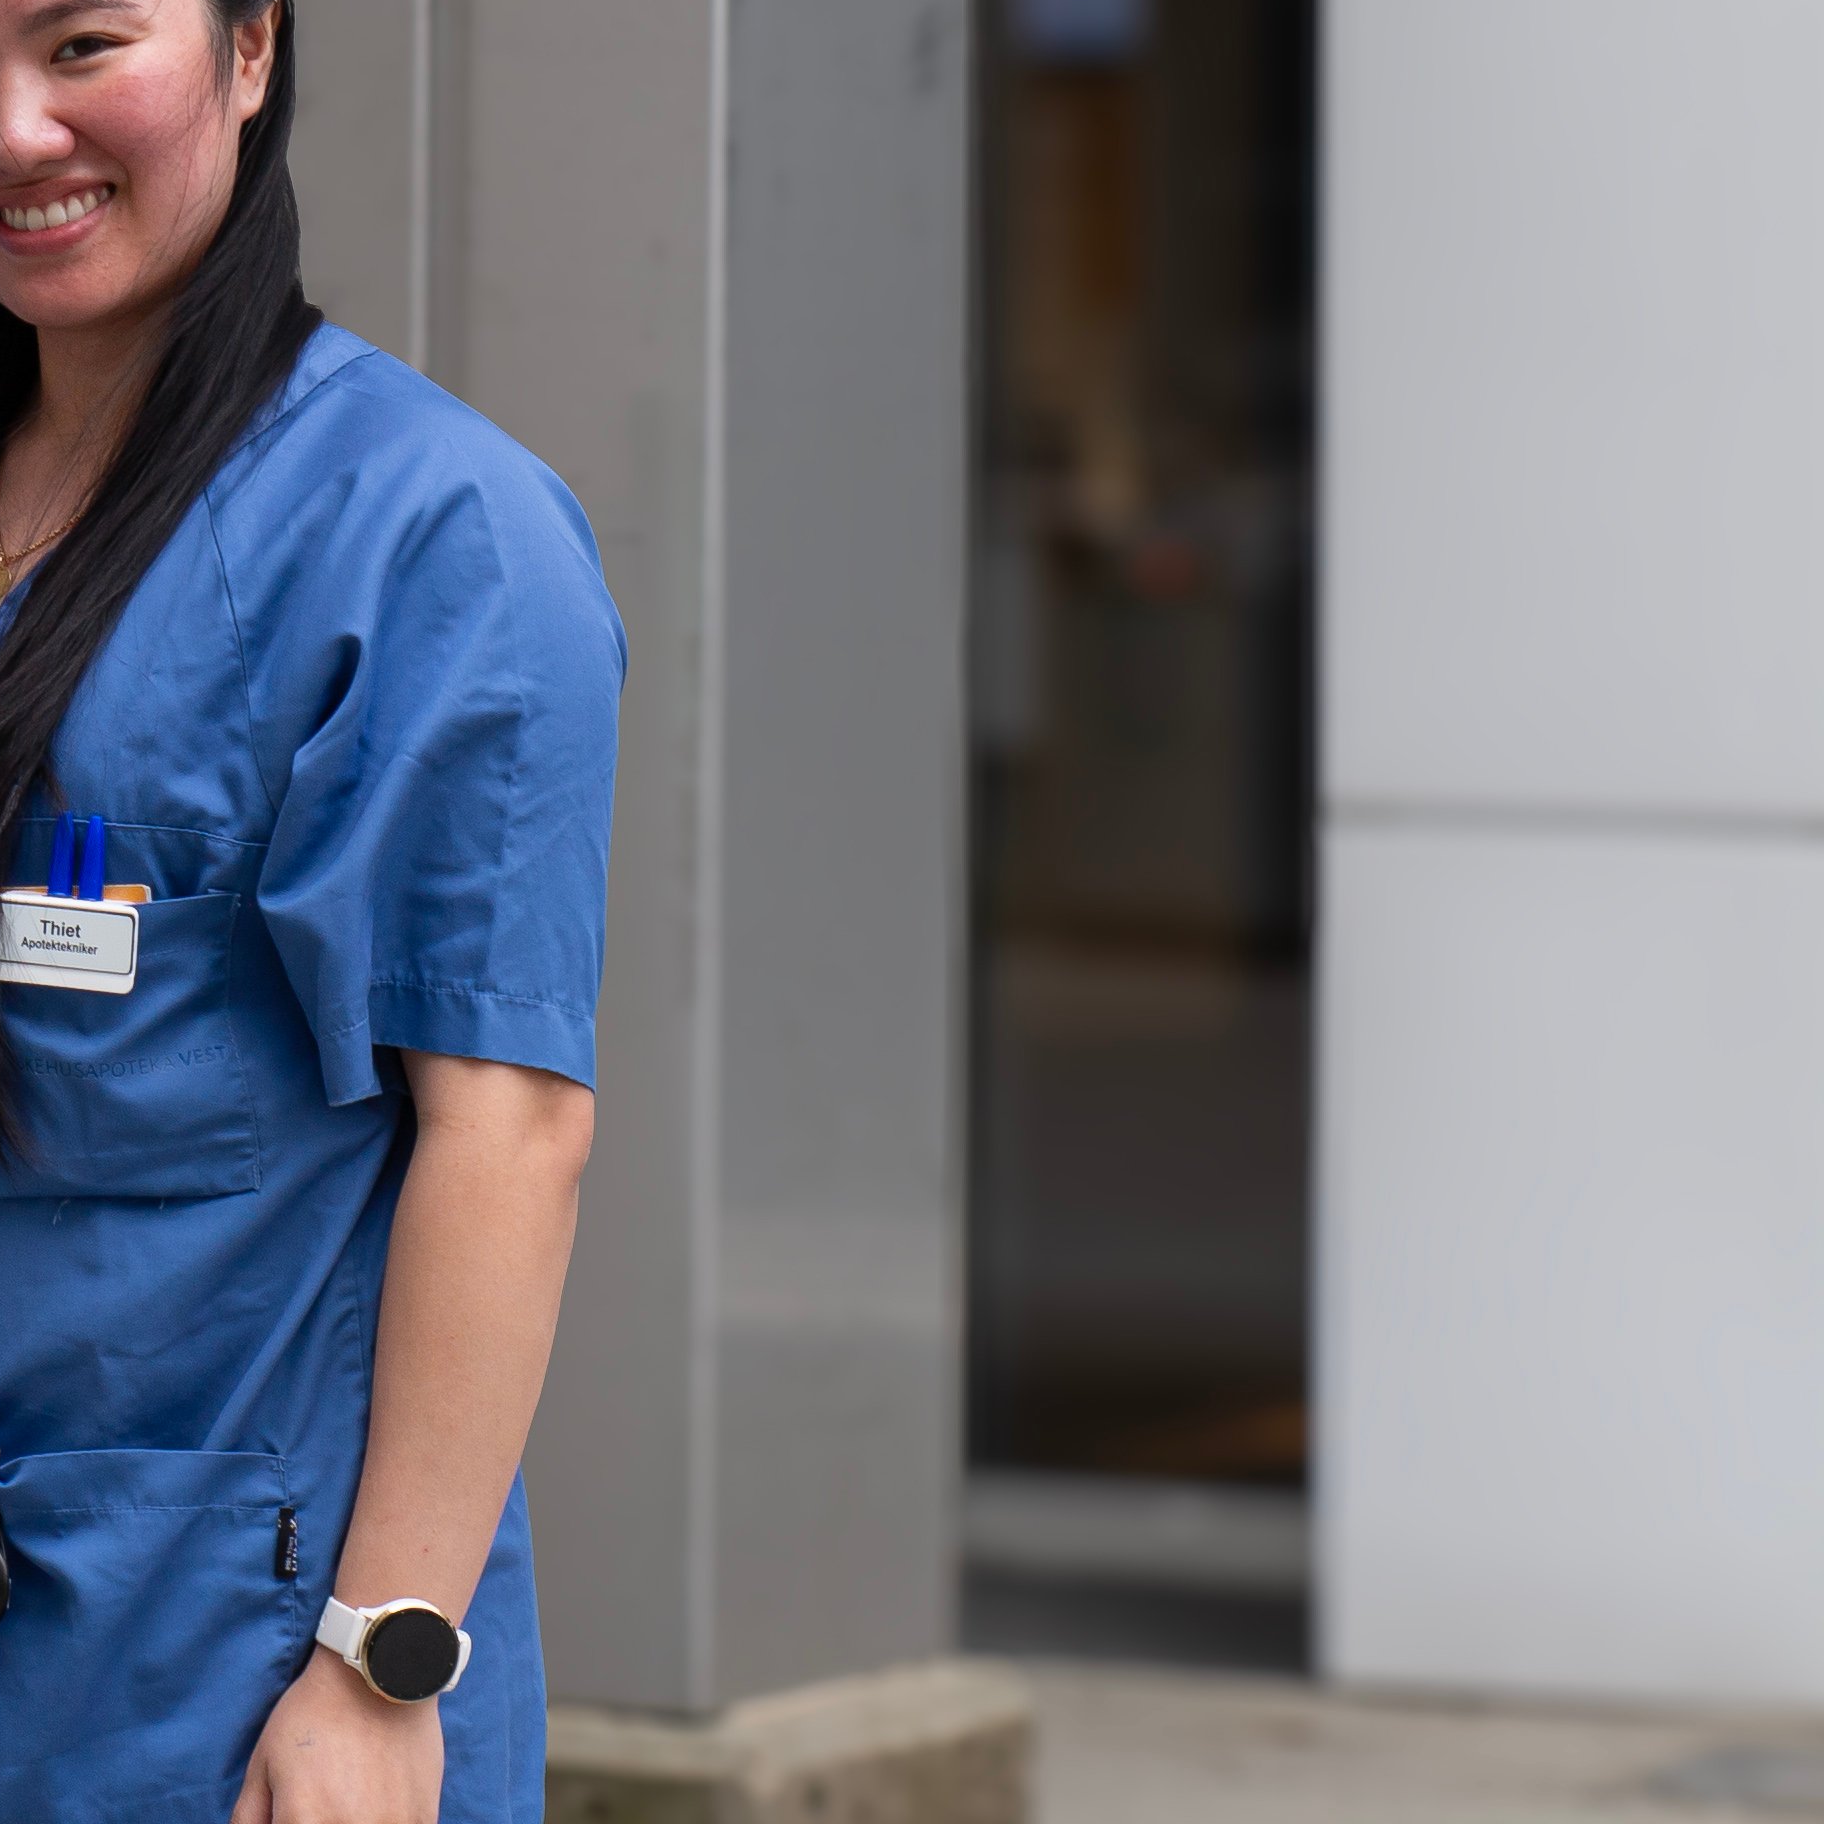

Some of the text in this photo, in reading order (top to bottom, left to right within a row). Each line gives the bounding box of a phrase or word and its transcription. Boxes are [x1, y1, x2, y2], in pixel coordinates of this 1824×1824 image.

[40, 919, 81, 939] Thiet
[21, 936, 98, 955] Apotektekniker
[178, 1045, 225, 1067] VEST
